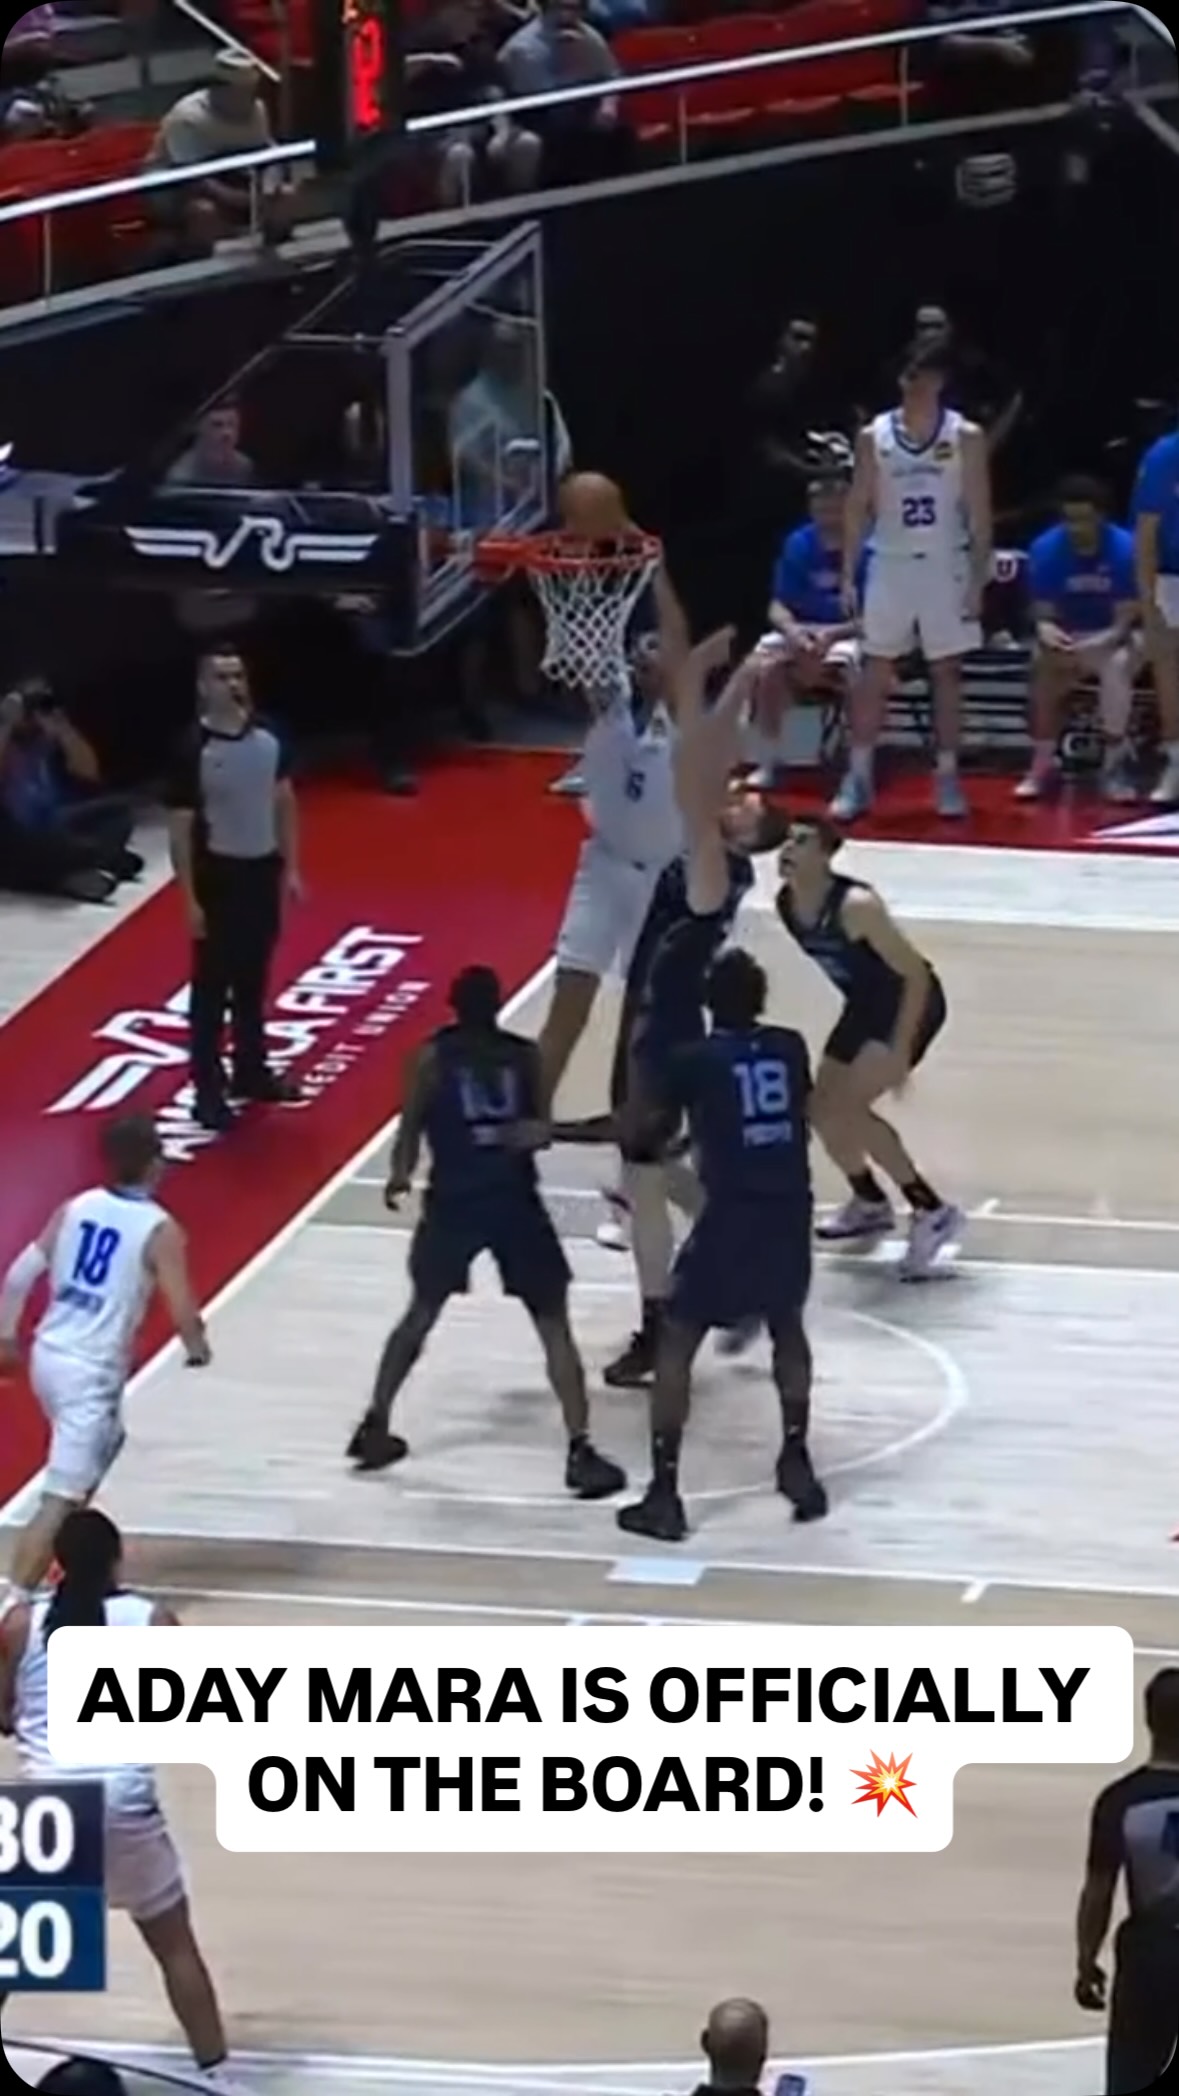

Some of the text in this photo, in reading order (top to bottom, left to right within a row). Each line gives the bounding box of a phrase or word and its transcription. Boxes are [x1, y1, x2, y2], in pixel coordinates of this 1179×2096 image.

[902, 495, 937, 528] 23
[274, 925, 424, 1015] FIRST
[732, 1058, 789, 1118] 18
[72, 1219, 121, 1286] 18
